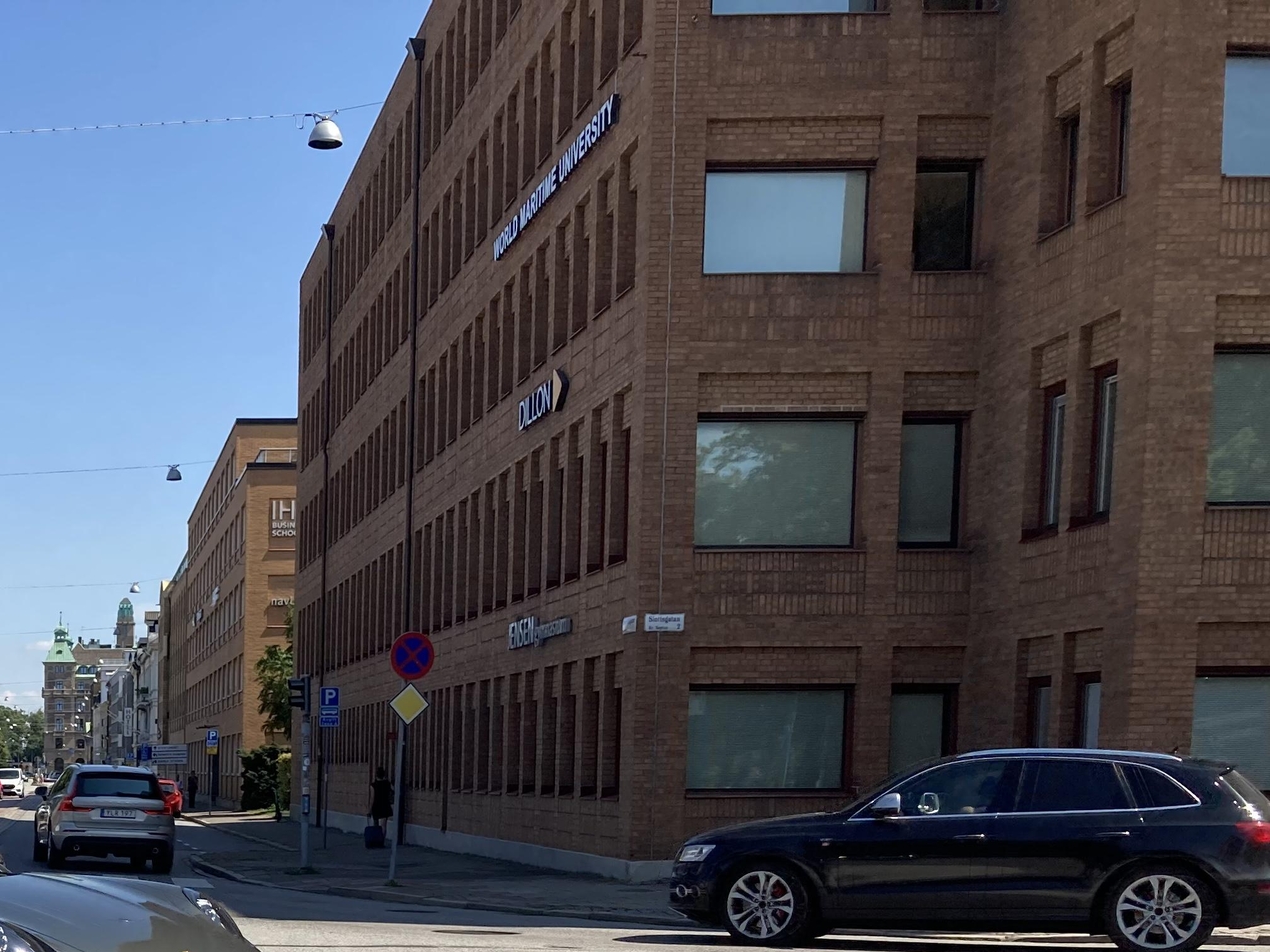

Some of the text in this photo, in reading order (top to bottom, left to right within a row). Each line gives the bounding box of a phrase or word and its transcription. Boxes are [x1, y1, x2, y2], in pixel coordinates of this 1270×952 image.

[493, 93, 614, 261] WORLD MARITIME UNIVERSITY
[518, 379, 551, 431] DILLON
[325, 689, 337, 705] P
[209, 731, 216, 740] P
